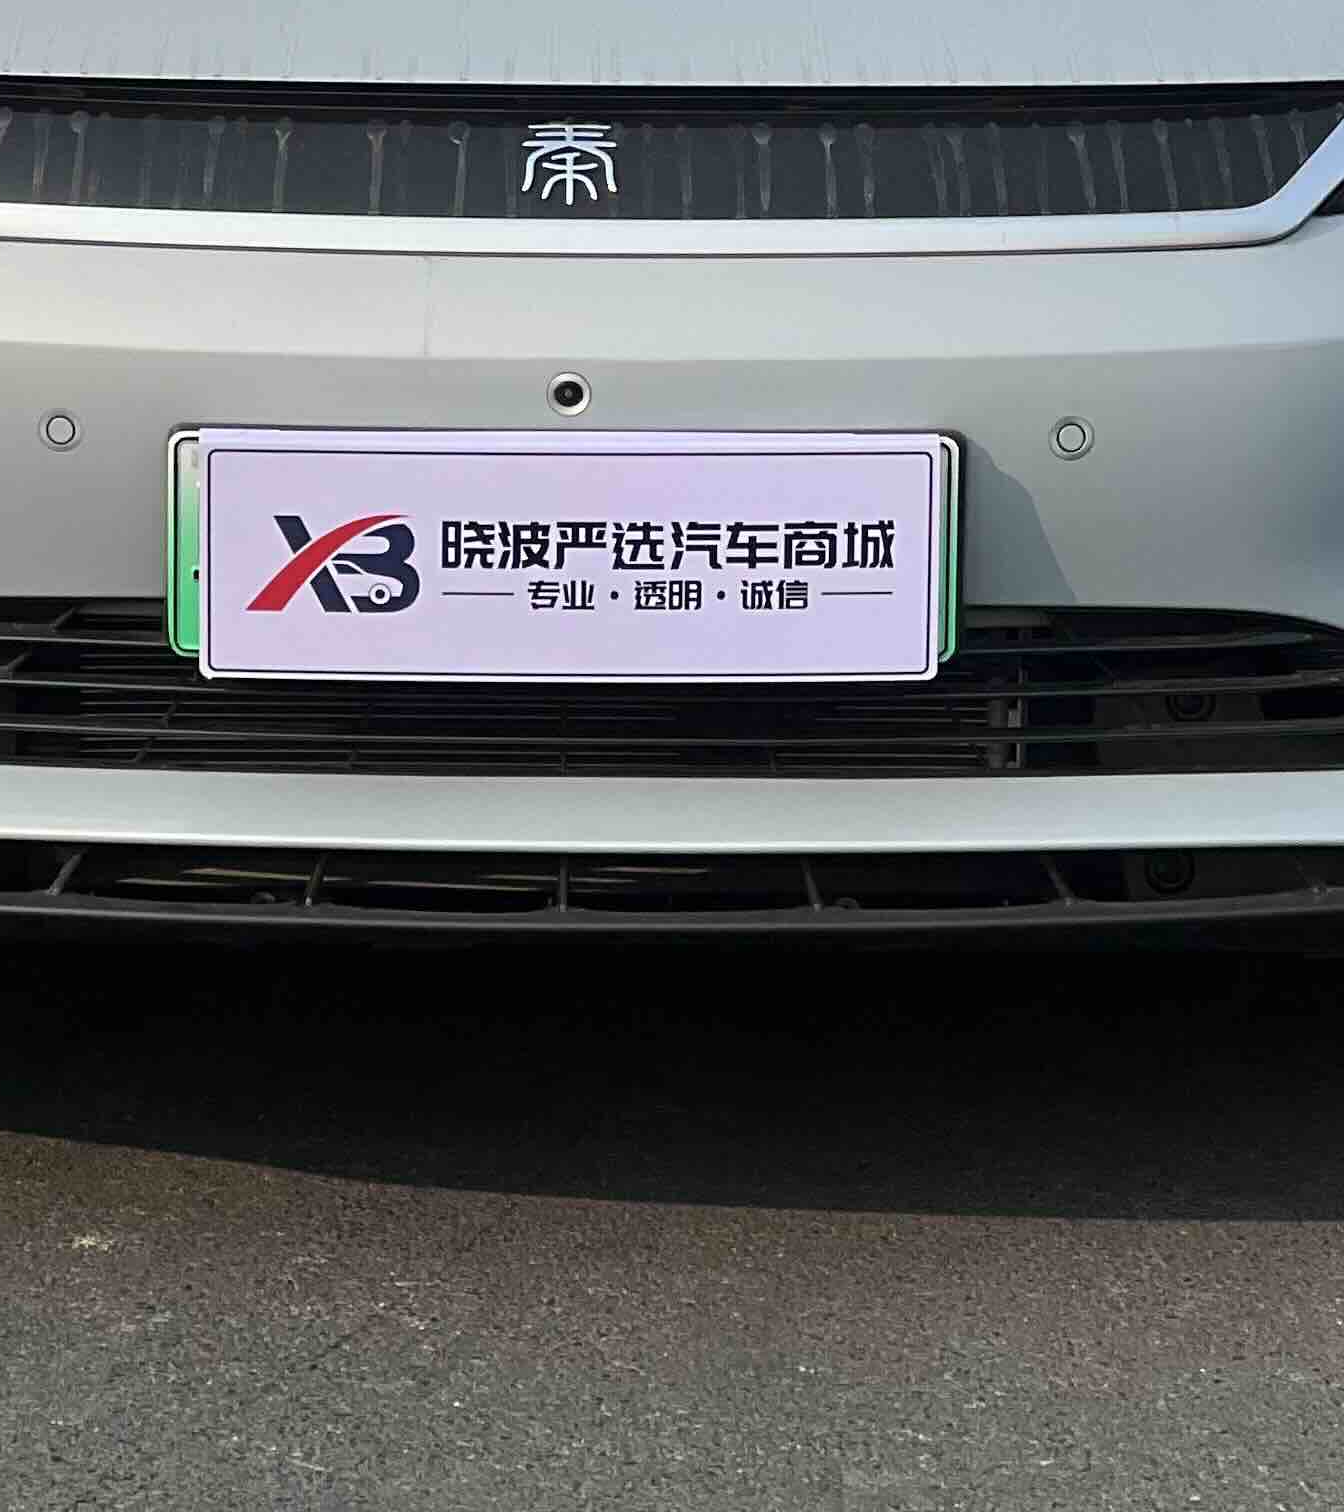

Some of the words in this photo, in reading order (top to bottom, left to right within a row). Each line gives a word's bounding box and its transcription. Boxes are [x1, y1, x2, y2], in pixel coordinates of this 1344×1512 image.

[441, 519, 895, 571] 晓波严选汽车商城
